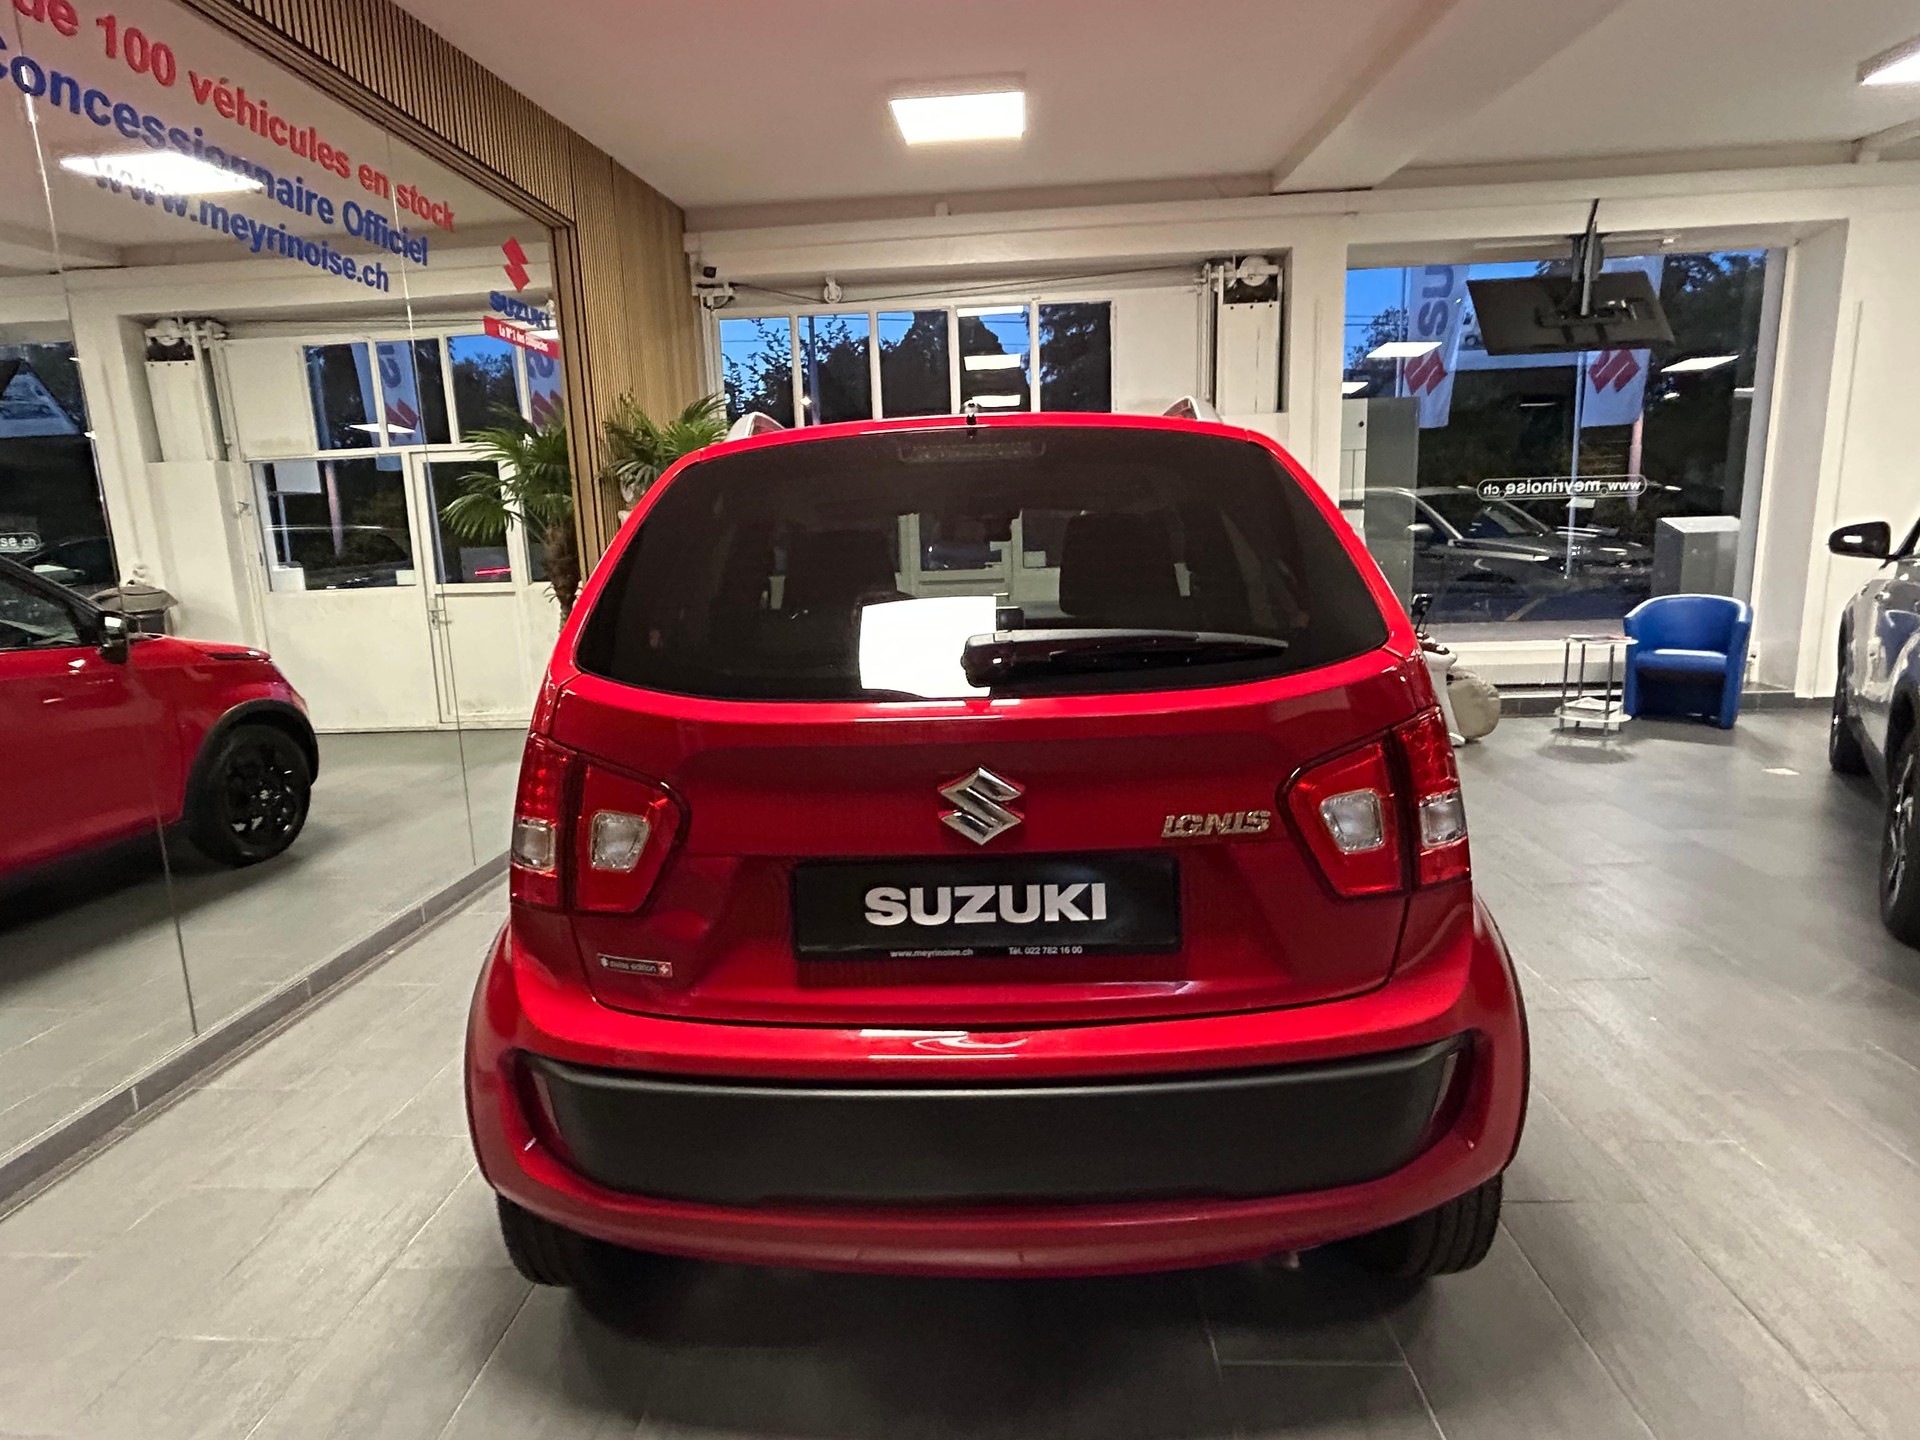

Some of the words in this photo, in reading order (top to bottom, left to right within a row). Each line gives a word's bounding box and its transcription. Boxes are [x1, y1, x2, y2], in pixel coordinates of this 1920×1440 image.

[96, 14, 176, 87] 100
[188, 70, 351, 179] véhicules
[357, 163, 390, 200] en
[396, 182, 455, 232] stock
[342, 200, 428, 266] Officiel
[1162, 810, 1271, 838] IGNIS
[864, 882, 1107, 926] SUZUKI
[890, 948, 974, 958] www.meyrinoise.ch
[1024, 946, 1041, 955] 022
[1042, 946, 1058, 955] 782
[1060, 946, 1070, 954] 16
[1071, 946, 1083, 954] 00
